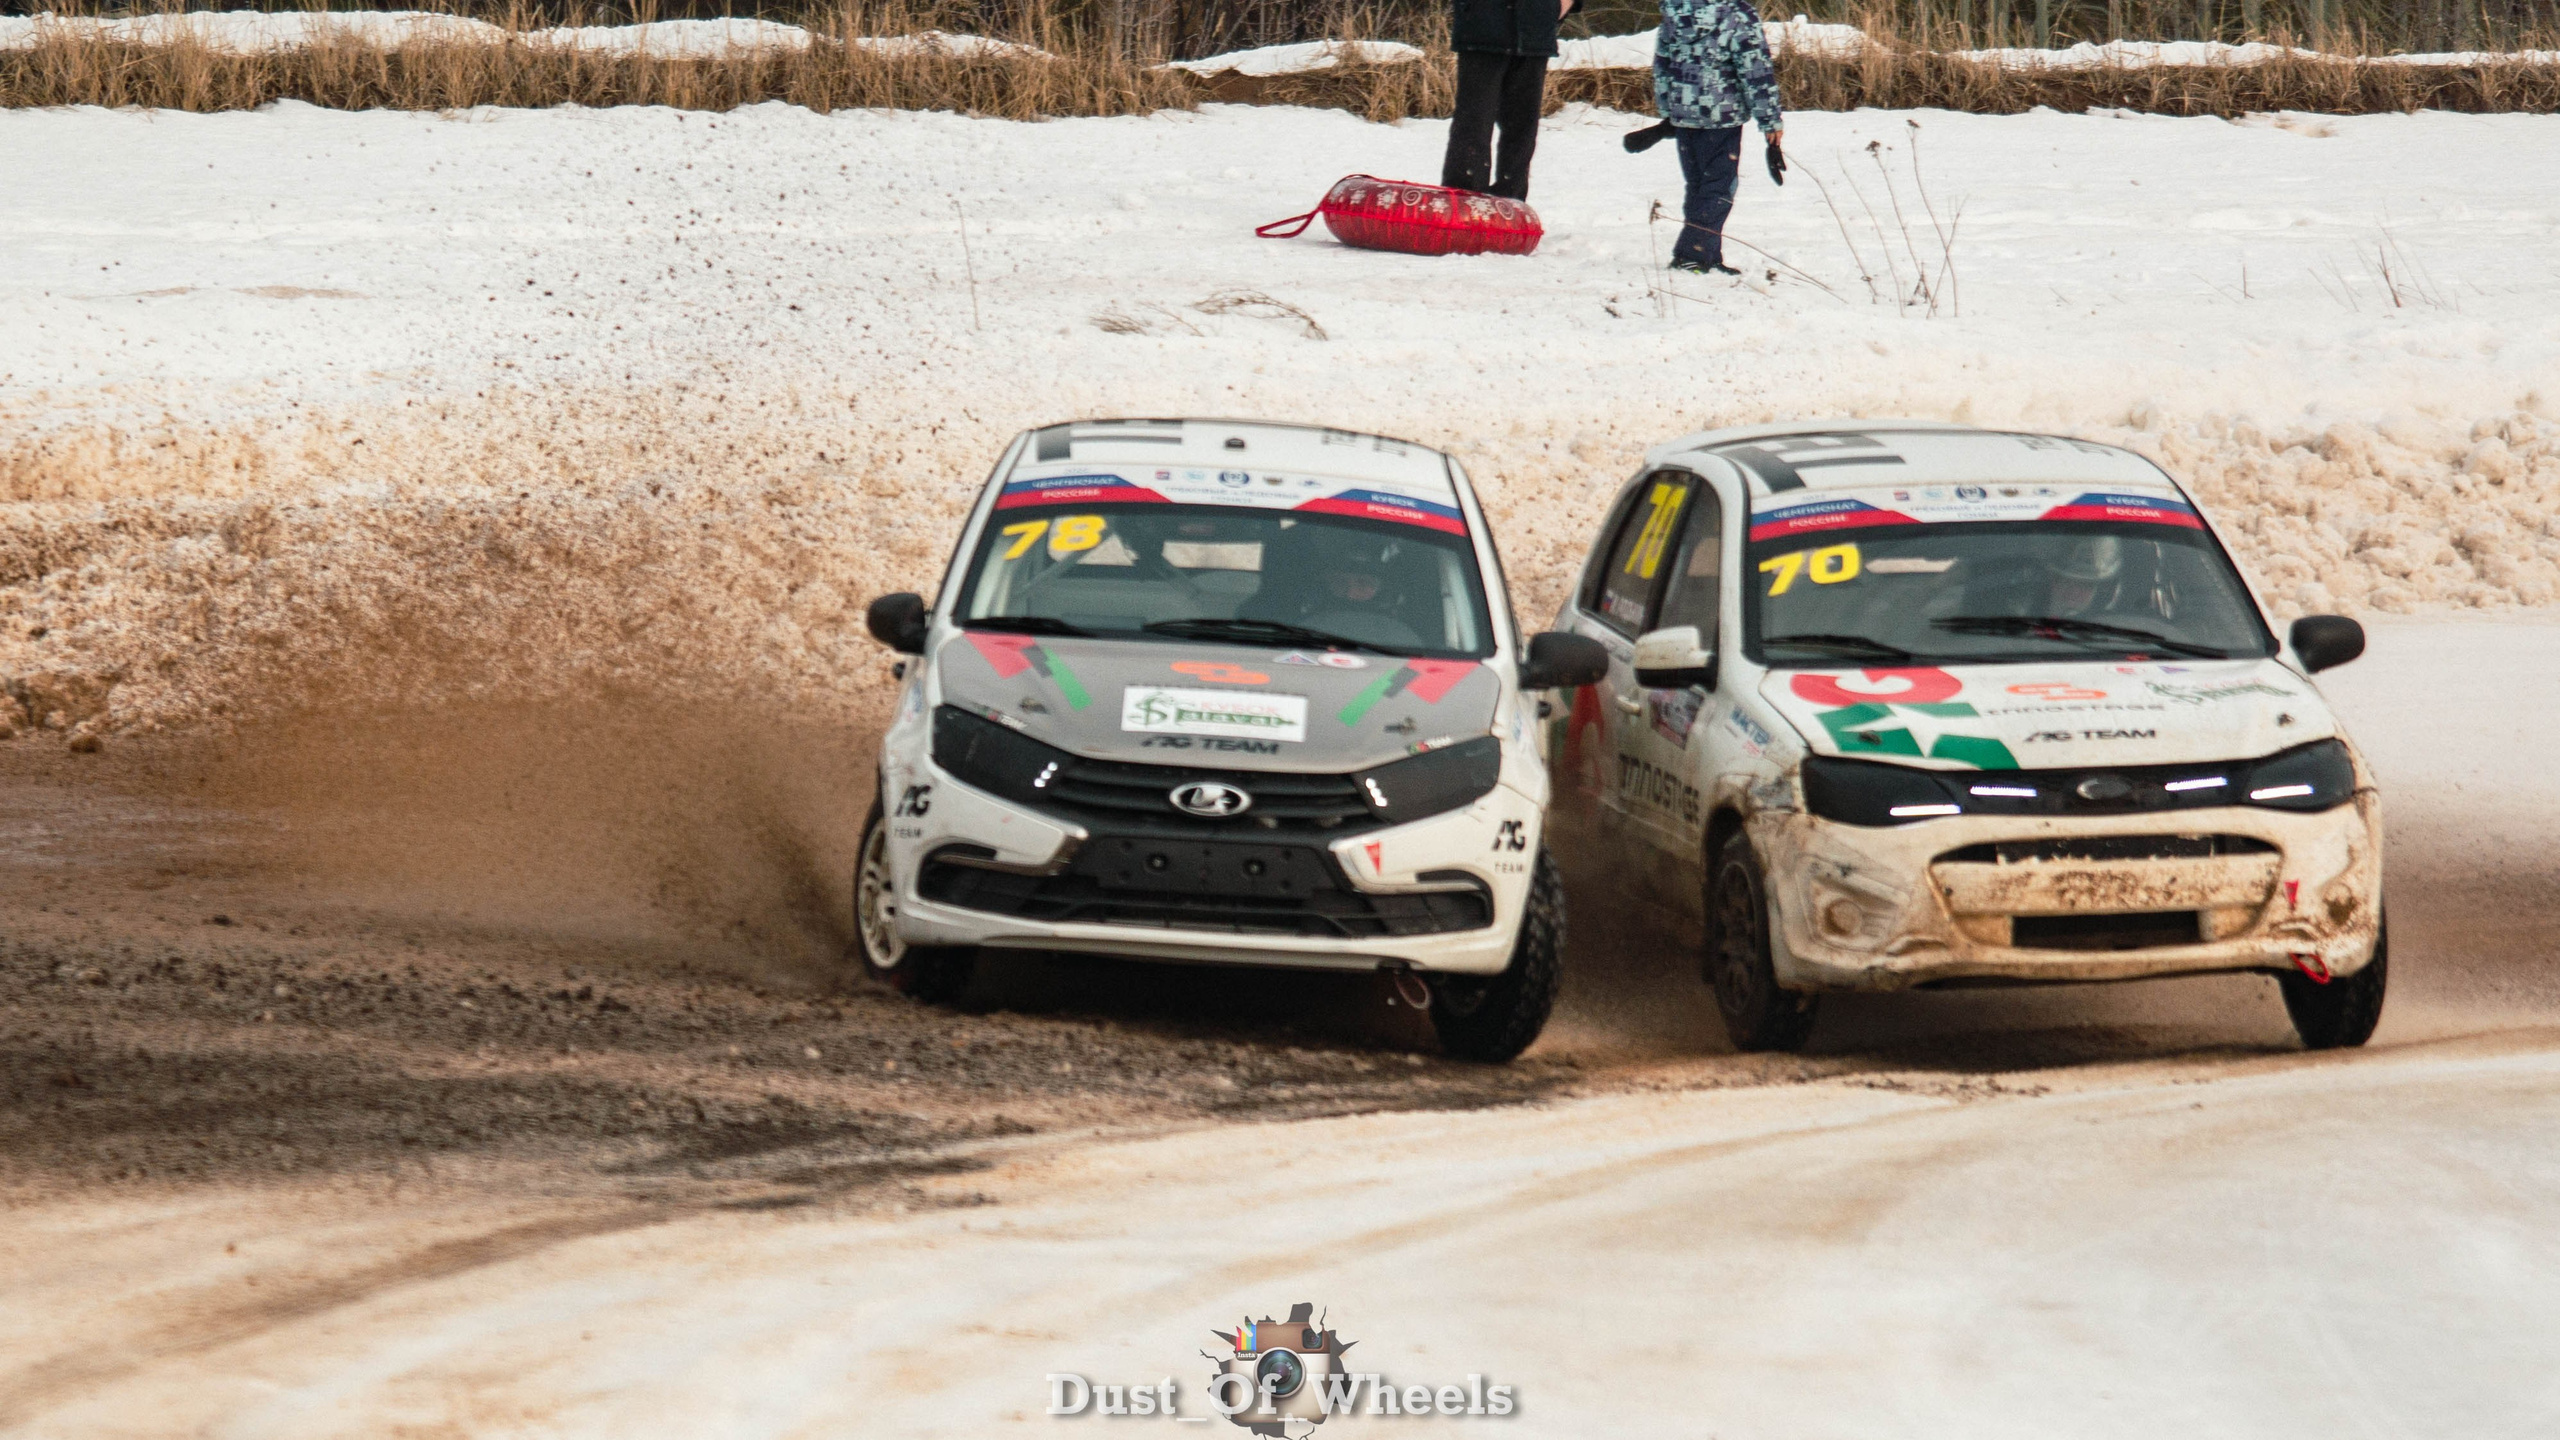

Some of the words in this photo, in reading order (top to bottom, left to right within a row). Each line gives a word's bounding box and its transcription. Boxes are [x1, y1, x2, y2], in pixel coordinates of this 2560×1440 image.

[1041, 488, 1101, 499] РОССИИ
[1371, 494, 1416, 508] КУБОК
[2105, 495, 2150, 507] КУБОК
[1366, 504, 1425, 520] РОССИИ
[1773, 501, 1857, 518] ЧЕМПИОНАТ
[2105, 506, 2161, 519] РОССИИ
[1788, 513, 1847, 528] РОССИИ
[1002, 514, 1107, 561] 78
[1624, 482, 1687, 580] 70
[1758, 542, 1860, 597] 70
[2083, 728, 2158, 742] TEAM
[1201, 738, 1281, 756] TEAM
